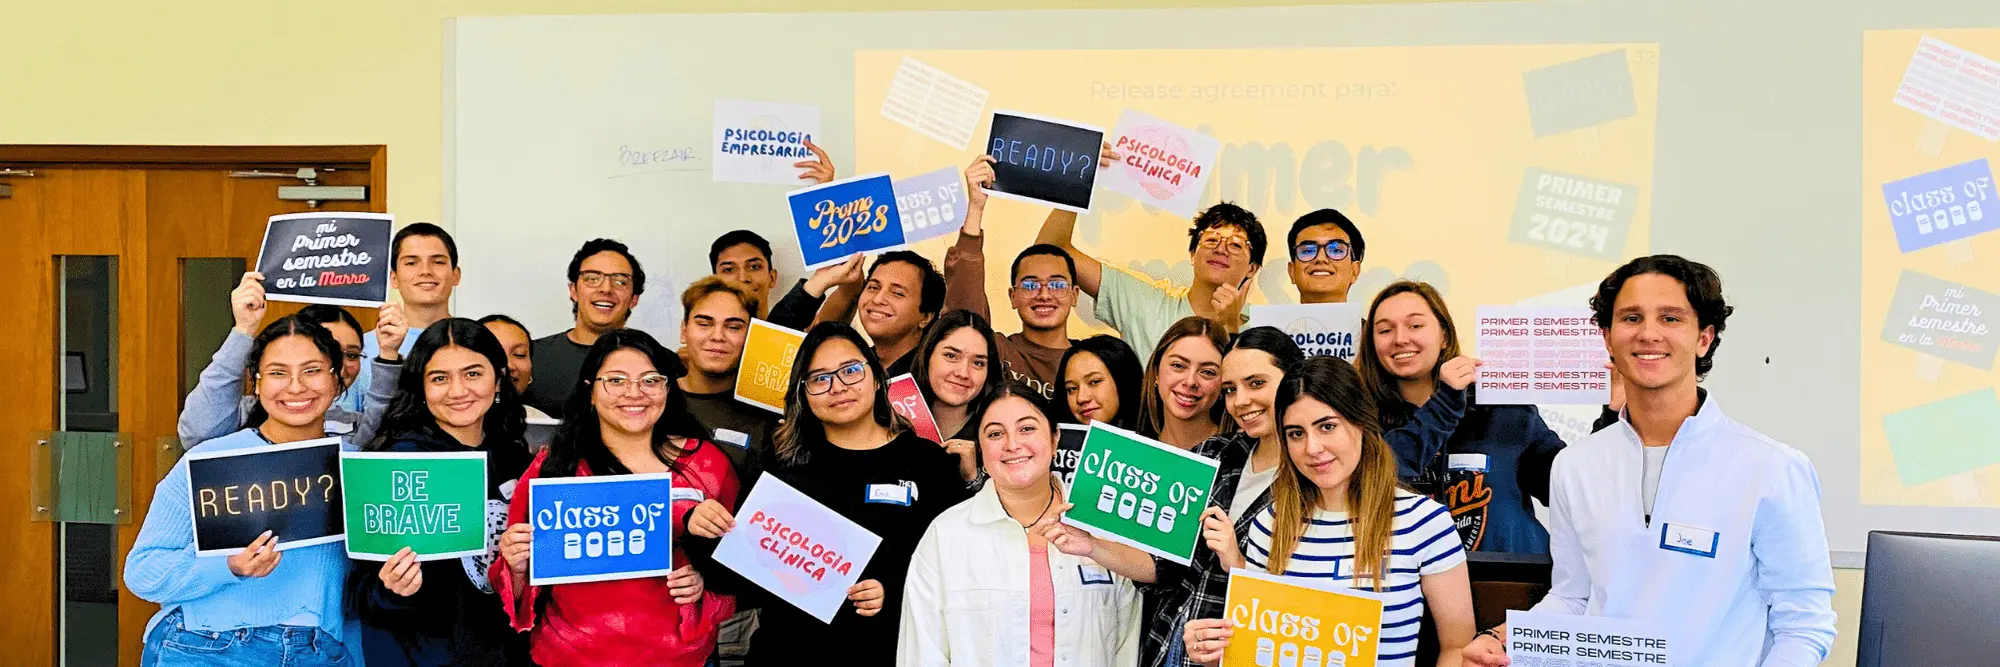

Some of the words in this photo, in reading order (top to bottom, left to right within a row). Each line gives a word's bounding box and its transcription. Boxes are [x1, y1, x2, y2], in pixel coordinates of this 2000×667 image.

[1091, 80, 1182, 99] Release
[1190, 81, 1326, 103] agreement
[1336, 82, 1397, 103] para:
[991, 137, 1091, 179] READY?
[1537, 173, 1622, 205] PRIMER
[808, 195, 874, 229] Promo
[898, 190, 931, 212] ass
[1535, 195, 1615, 221] SEMESTRE
[1891, 185, 1955, 217] class
[316, 220, 337, 234] mi
[820, 204, 888, 250] 2028
[1527, 213, 1610, 253] 2024
[283, 248, 372, 271] semestre
[276, 277, 296, 289] en
[299, 272, 317, 288] la
[1944, 286, 1964, 299] mi
[1481, 318, 1528, 326] PRIMER
[1533, 318, 1597, 326] SEMEST
[1481, 328, 1528, 337] PRIMER
[1907, 315, 1988, 336] semestre
[1898, 332, 1916, 344] en
[1919, 332, 1934, 346] la
[1481, 371, 1528, 379] PRIMER
[1533, 371, 1606, 379] SEMESTRE
[1481, 382, 1528, 390] PRIMER
[1533, 382, 1606, 390] SEMESTRE
[1084, 448, 1160, 495] class
[200, 474, 334, 518] READY?
[392, 470, 429, 501] BE
[364, 503, 461, 535] BRAVE
[537, 500, 620, 531] class
[1232, 598, 1320, 641] class
[1513, 627, 1570, 641] PRIMER
[1576, 632, 1666, 649] SEMESTRE
[1513, 642, 1570, 655] PRIMER
[1576, 646, 1666, 664] SEMESTRE
